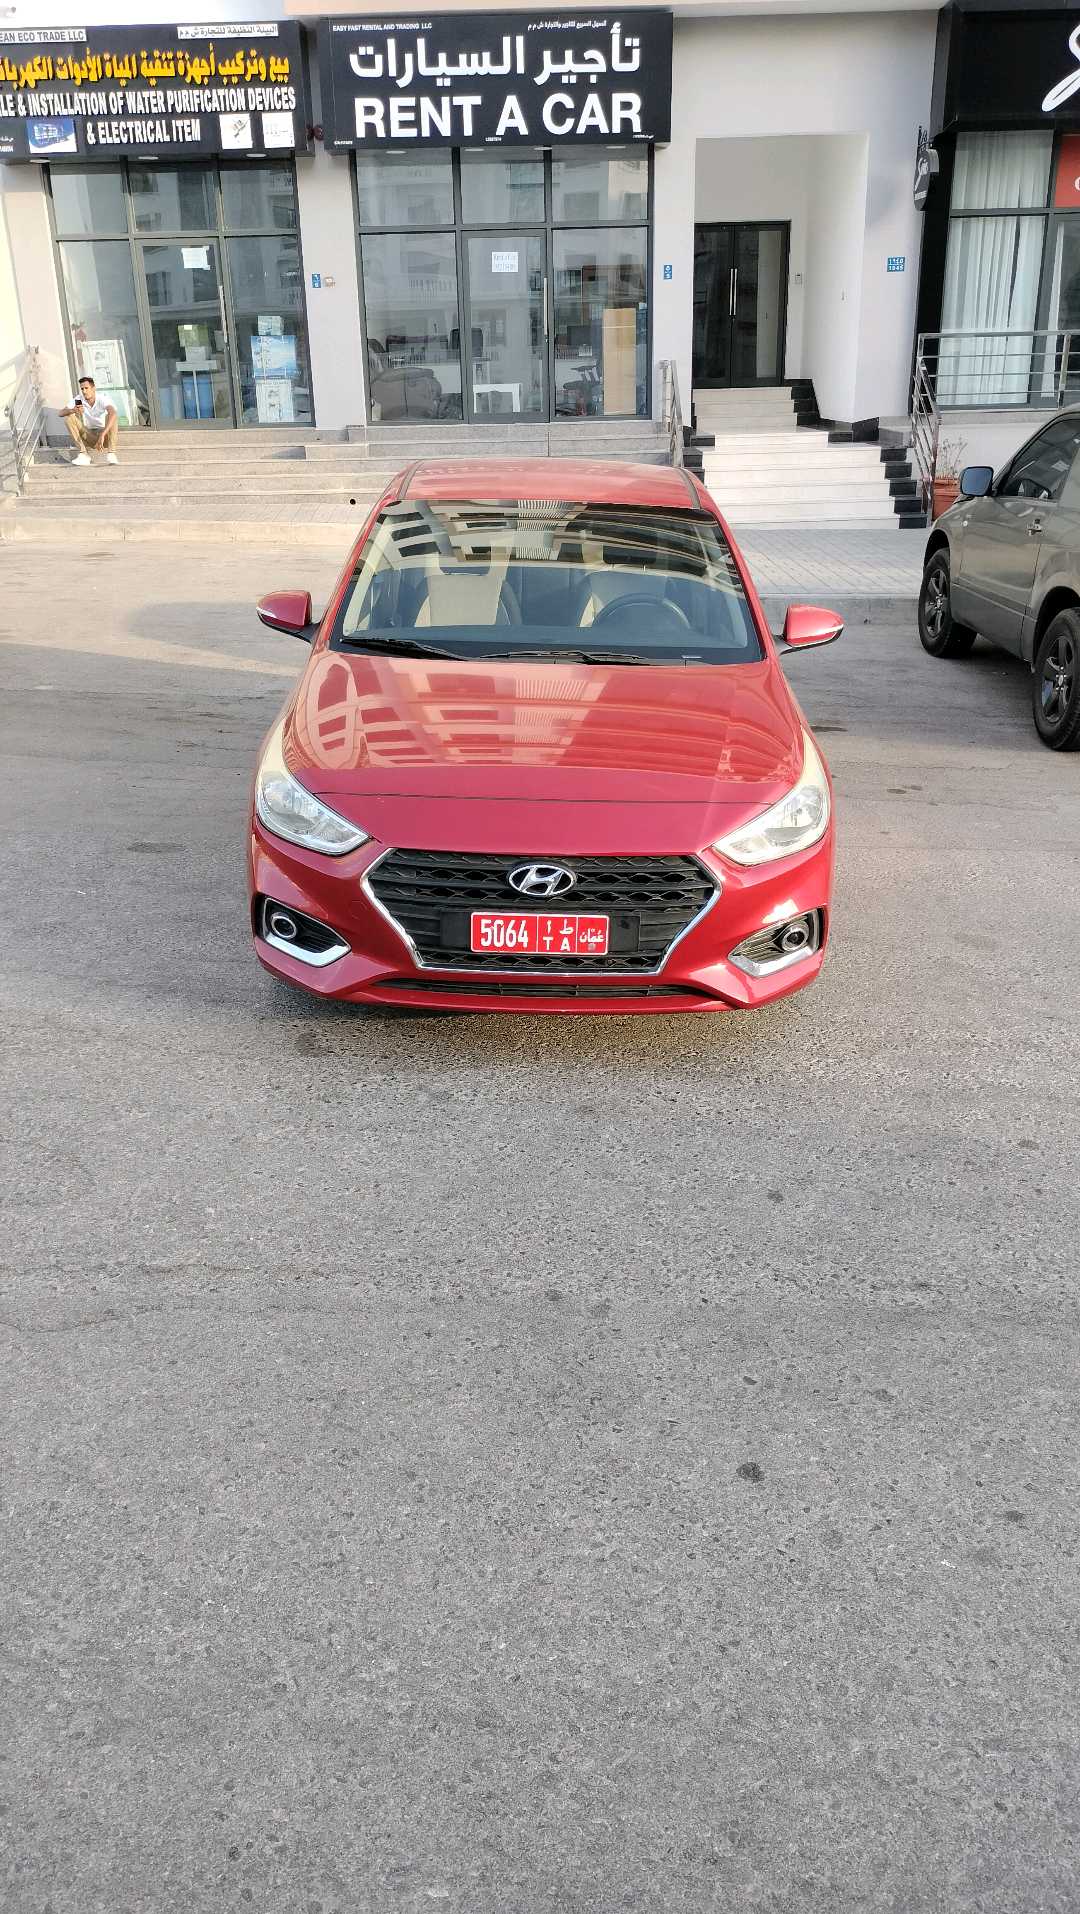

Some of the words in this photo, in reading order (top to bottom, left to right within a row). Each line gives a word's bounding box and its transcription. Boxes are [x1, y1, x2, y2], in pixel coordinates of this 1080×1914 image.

[18, 32, 35, 41] ECO
[36, 31, 66, 41] TRADE
[68, 30, 84, 41] LLC
[176, 41, 215, 86] أجهزة
[349, 34, 525, 89] السيارات
[533, 21, 641, 86] تأجير
[269, 55, 290, 84] بيع
[18, 94, 27, 116] &
[27, 91, 108, 116] INSTALLATION
[108, 91, 125, 115] OF
[125, 90, 167, 114] WATER
[166, 88, 247, 113] PURIFICATION
[247, 86, 296, 111] DEVICES
[354, 95, 482, 139] RENT
[495, 94, 529, 136] A
[542, 92, 642, 135] CAR
[86, 122, 96, 145] &
[98, 119, 171, 144] ELECTRICAL
[171, 118, 201, 142] ITEM
[480, 918, 529, 948] 5064
[543, 936, 554, 951] T
[560, 937, 571, 952] A
